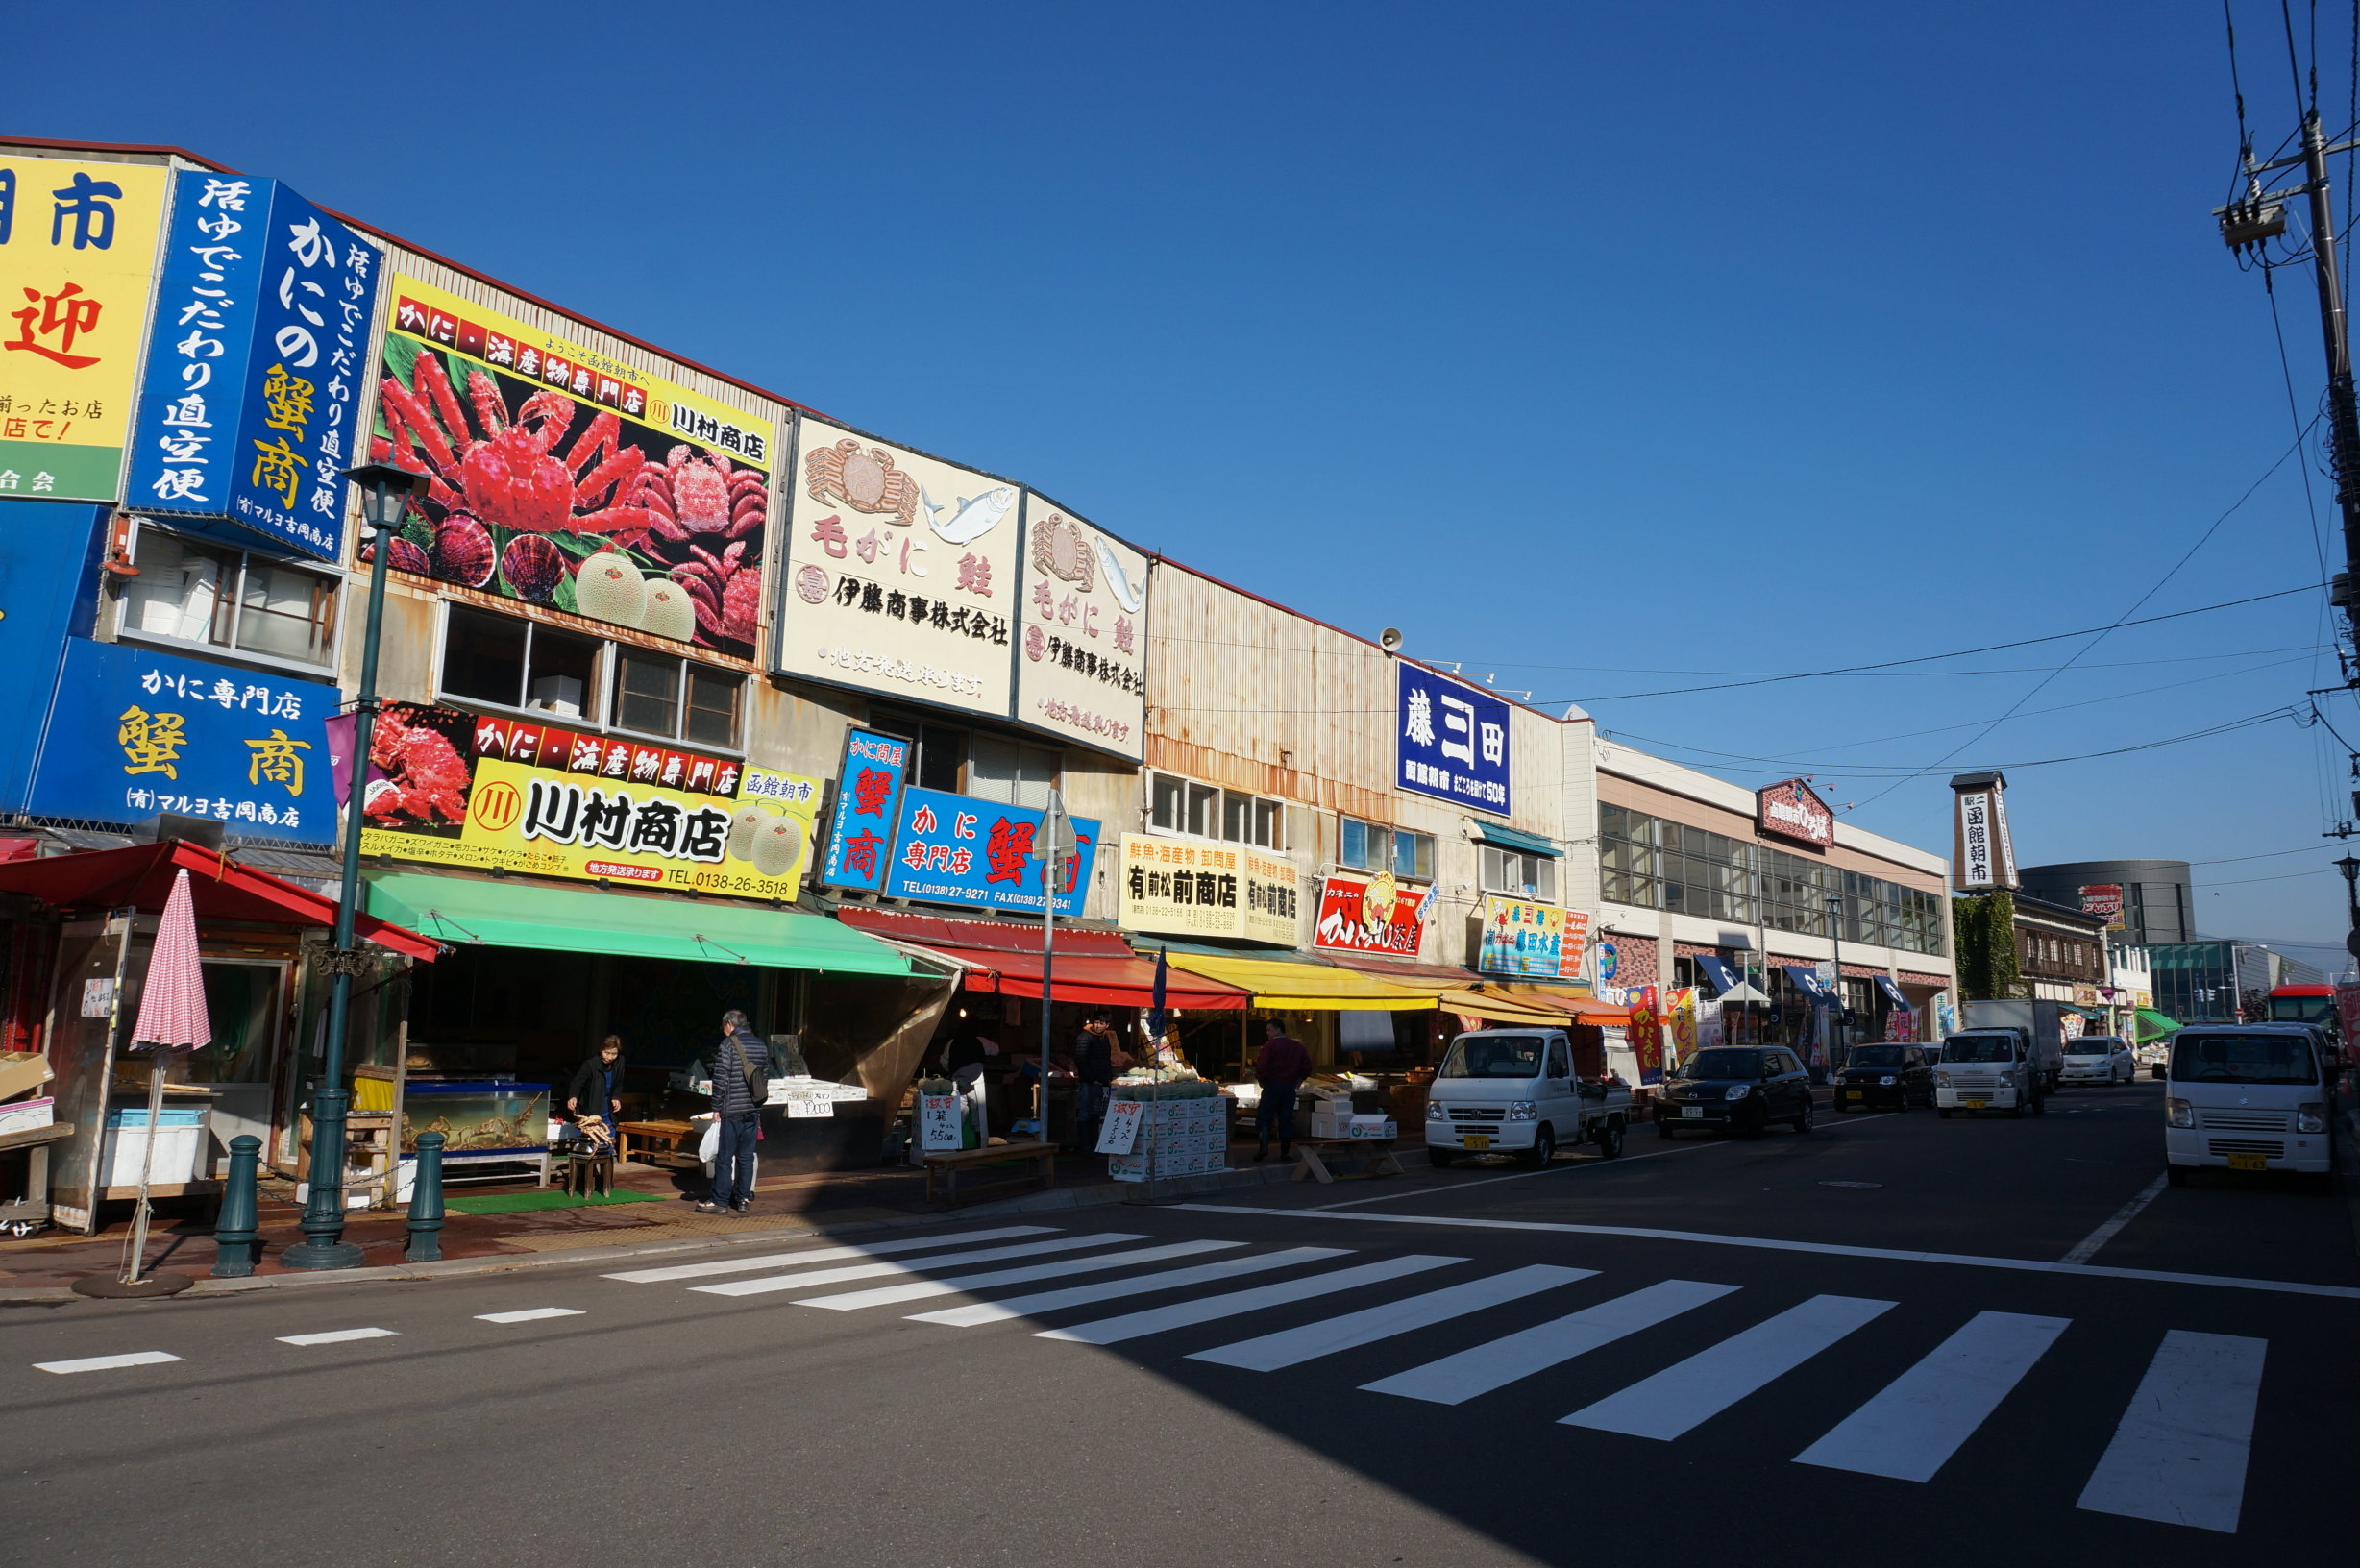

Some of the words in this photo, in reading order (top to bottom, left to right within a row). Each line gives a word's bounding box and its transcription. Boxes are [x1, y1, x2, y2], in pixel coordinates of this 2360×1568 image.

[0, 168, 123, 250] 市
[4, 282, 103, 369] 迎
[152, 179, 252, 502] 活ゆでこだわり直空便
[546, 338, 650, 386] ようこそ函館朝市へ
[672, 402, 766, 463] 川村商店
[831, 576, 1009, 646] 伊藤商事株式会社
[142, 669, 302, 720] かに専門店
[1045, 635, 1143, 697] 伊藤商事株式会社
[478, 724, 739, 794] かに・海産物専門店
[850, 738, 902, 767] かに問屋
[746, 774, 813, 801] 函館朝市
[525, 781, 730, 859] 川村商店
[912, 804, 978, 839] かに
[1967, 806, 1986, 881] 函館朝市
[589, 863, 660, 880] 地方発送承ります
[668, 869, 788, 895] TEL.0138-26-3518
[902, 841, 973, 875] 専門店
